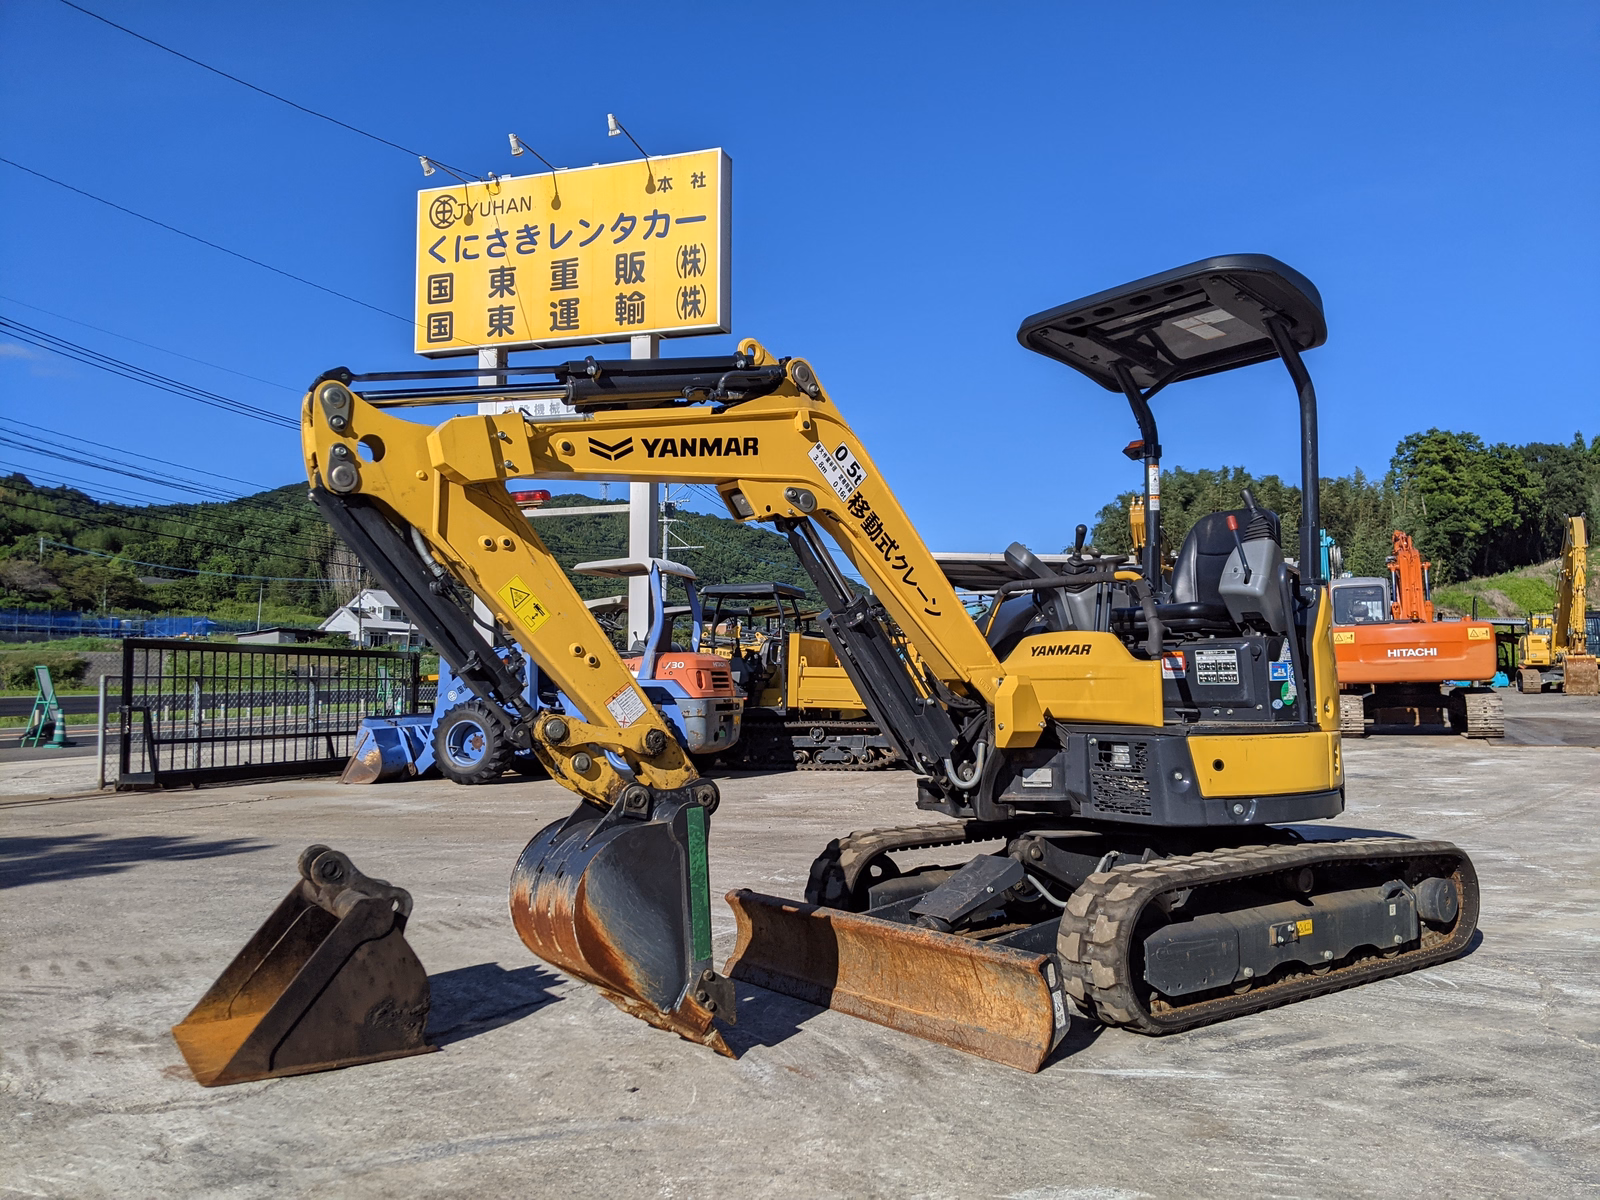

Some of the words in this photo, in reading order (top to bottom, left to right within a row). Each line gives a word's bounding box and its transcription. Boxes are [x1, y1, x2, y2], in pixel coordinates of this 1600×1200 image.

[657, 171, 706, 193] 本社
[453, 195, 532, 220] JYUHAN
[428, 208, 707, 263] くにさきレンタカー
[641, 437, 759, 459] YANMAR
[835, 445, 862, 485] 0.5t
[847, 490, 942, 616] 移動式クレーン
[1030, 644, 1092, 657] YANMAR
[1387, 647, 1437, 658] HITACHI
